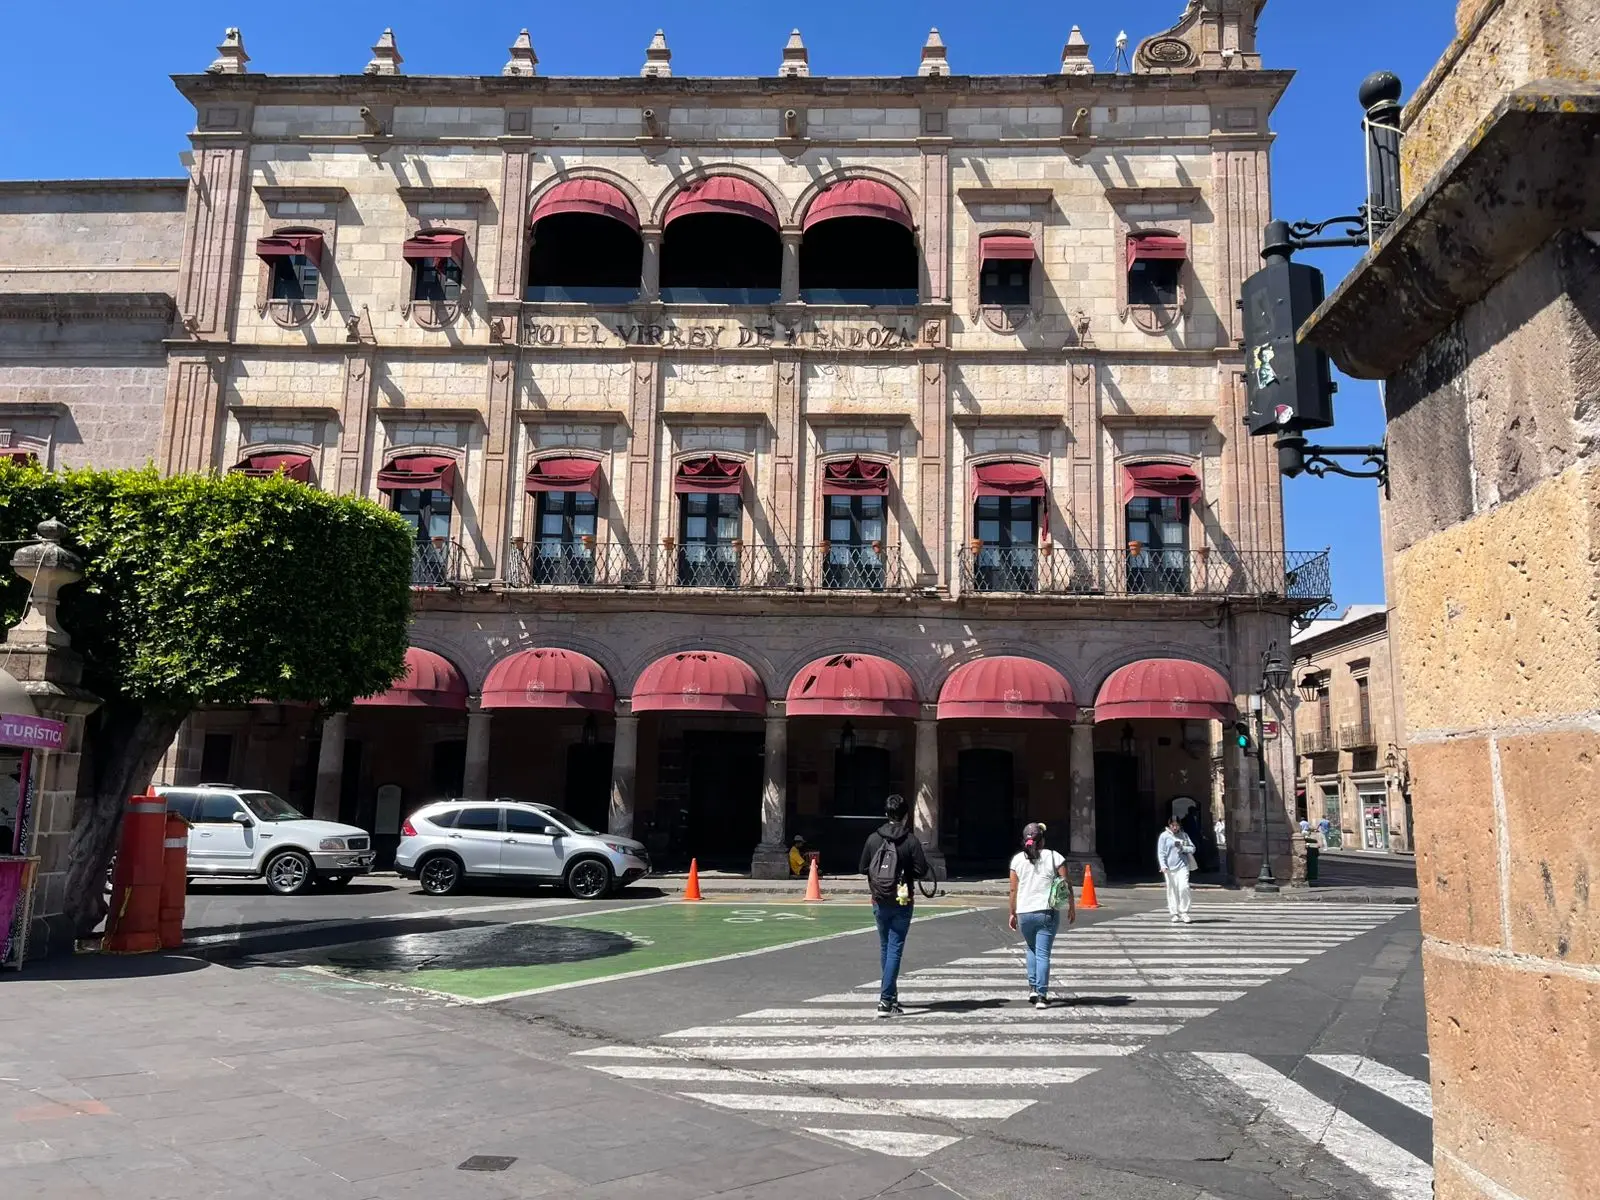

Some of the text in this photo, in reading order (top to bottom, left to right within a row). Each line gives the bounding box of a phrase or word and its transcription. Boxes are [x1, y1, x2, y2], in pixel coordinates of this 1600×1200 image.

[523, 324, 913, 348] HOTEL VIRREY DE MENDOZA
[3, 723, 62, 743] TURÍSTICA
